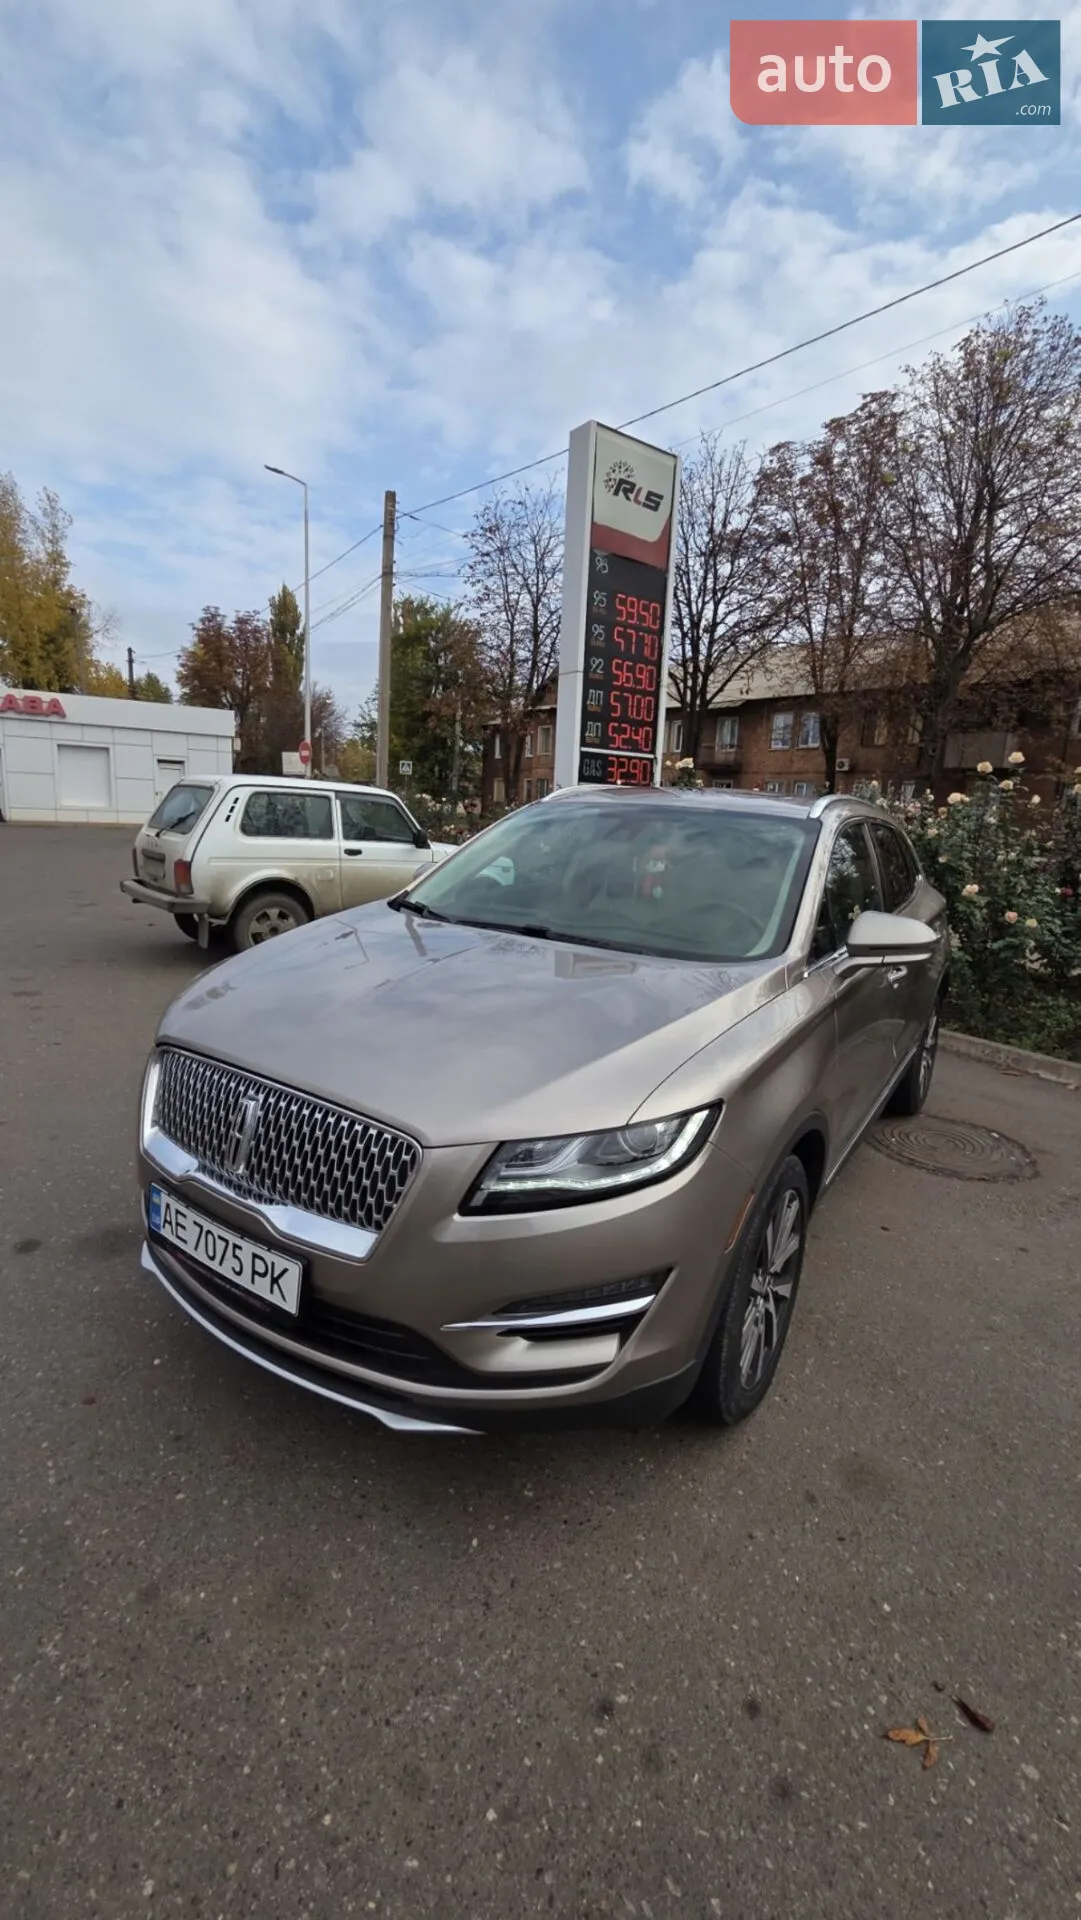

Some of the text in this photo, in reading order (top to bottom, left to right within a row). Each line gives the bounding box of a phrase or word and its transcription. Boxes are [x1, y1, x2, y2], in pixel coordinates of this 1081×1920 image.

[612, 478, 664, 512] RLS
[593, 590, 660, 629] 95 59.50
[592, 624, 605, 641] 95
[590, 657, 604, 673] 92
[587, 689, 603, 705] ДП
[586, 721, 602, 737] ДП
[583, 758, 602, 776] GAS
[162, 1203, 289, 1302] AE 7075 PK
